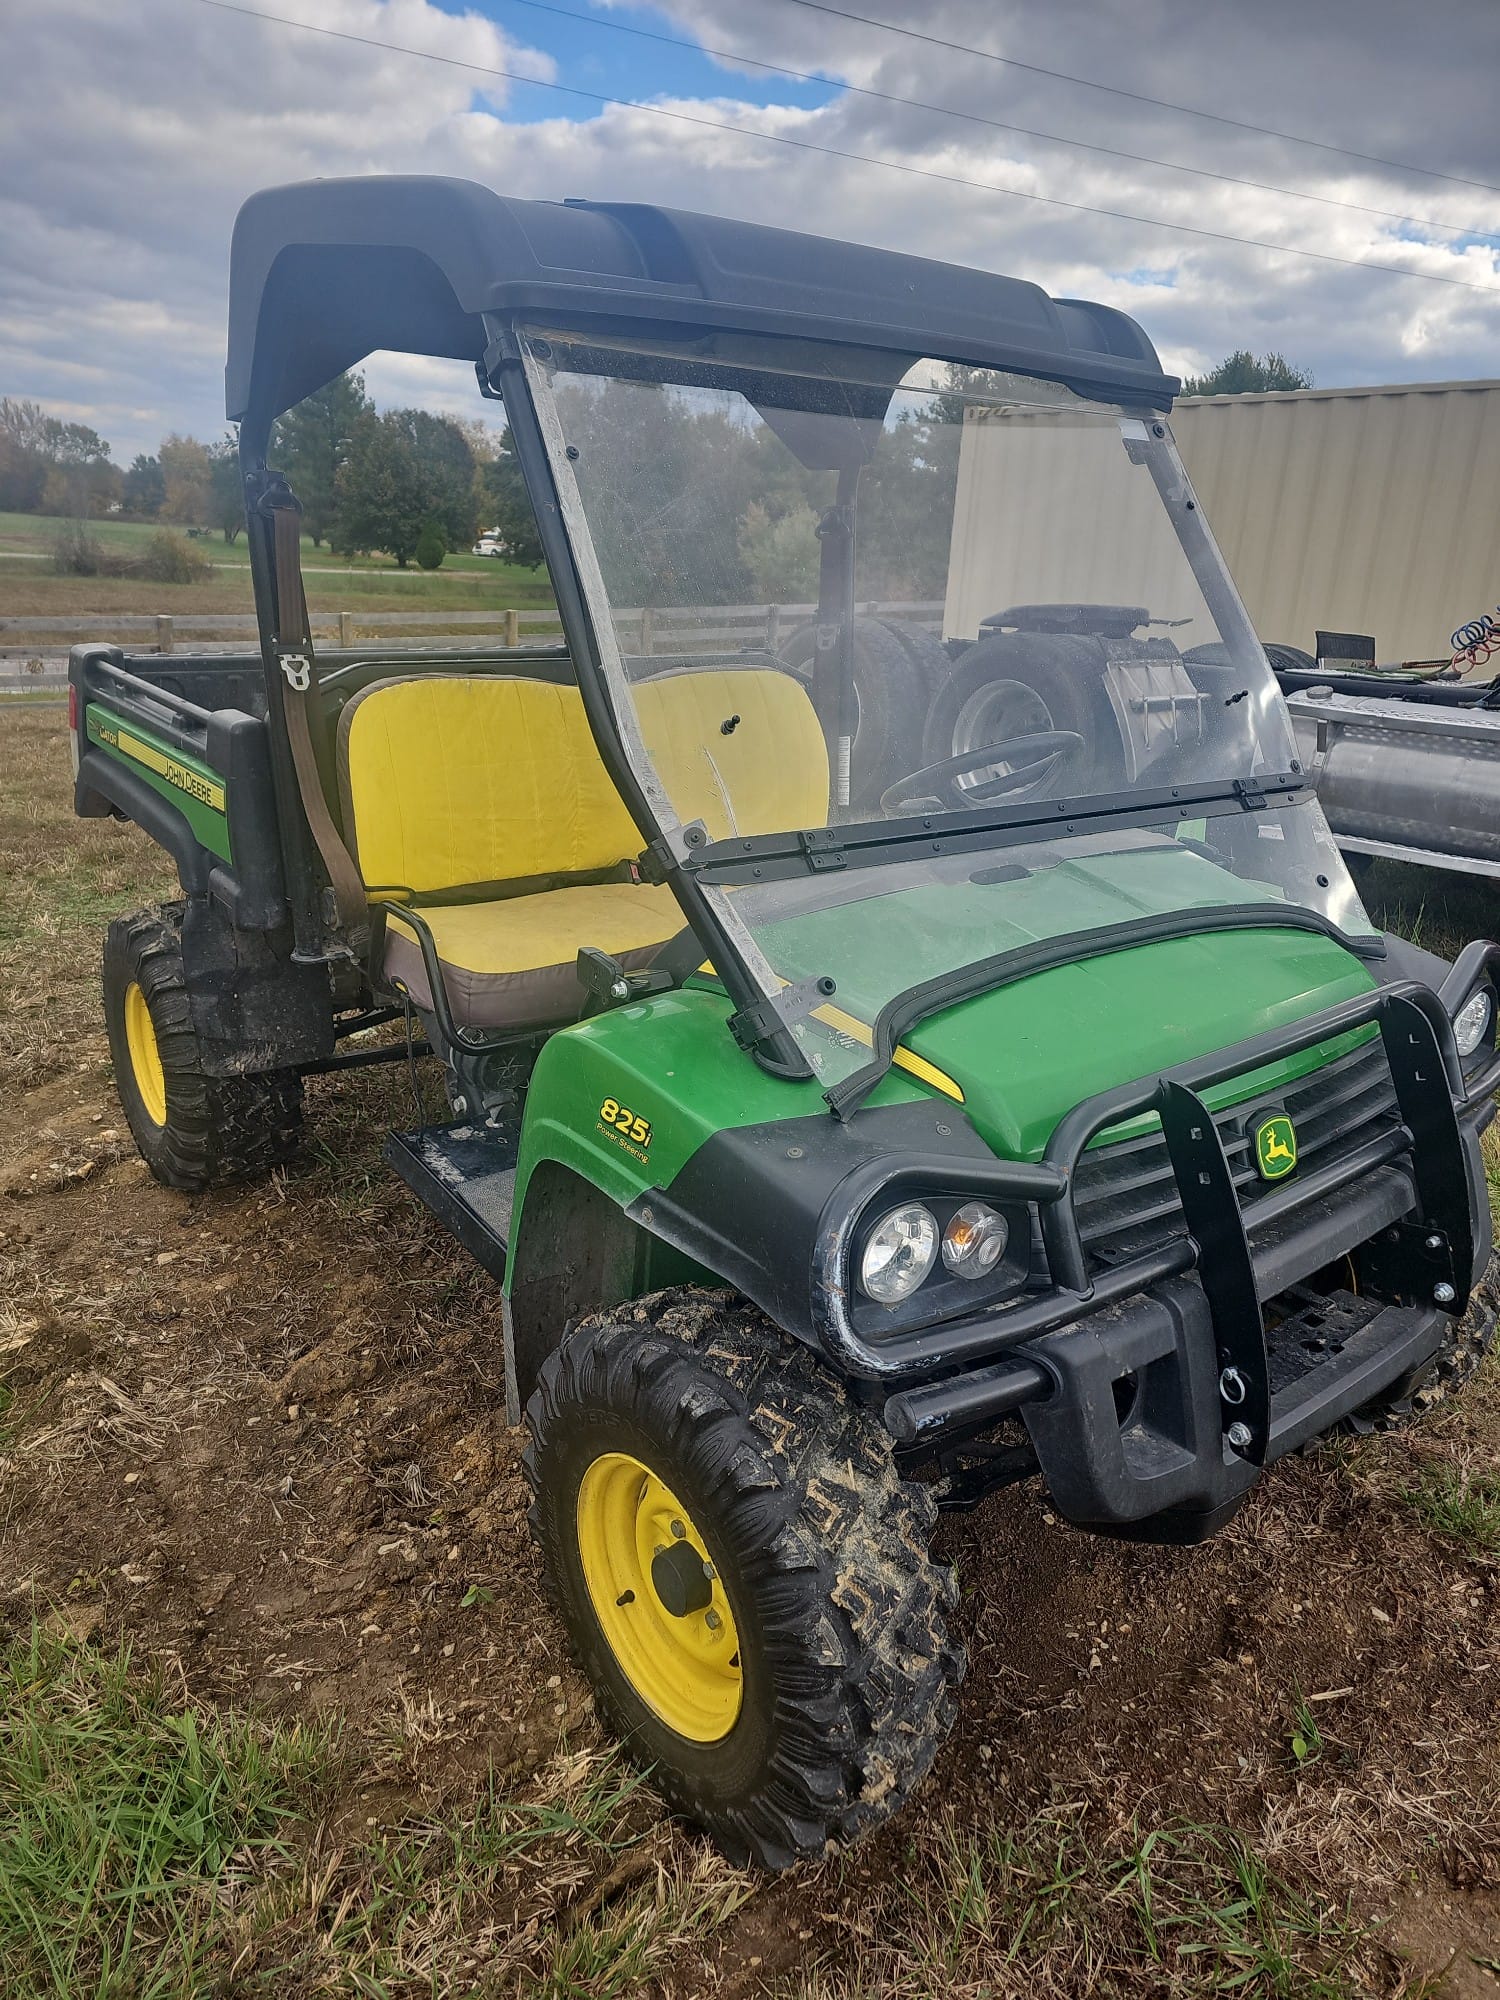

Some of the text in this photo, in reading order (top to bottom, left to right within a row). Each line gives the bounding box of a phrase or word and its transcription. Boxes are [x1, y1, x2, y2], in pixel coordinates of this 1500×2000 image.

[99, 725, 118, 747] GATOR
[165, 759, 212, 805] JOHN DEERE
[596, 1121, 650, 1165] Power Steering
[600, 1097, 653, 1149] 825i
